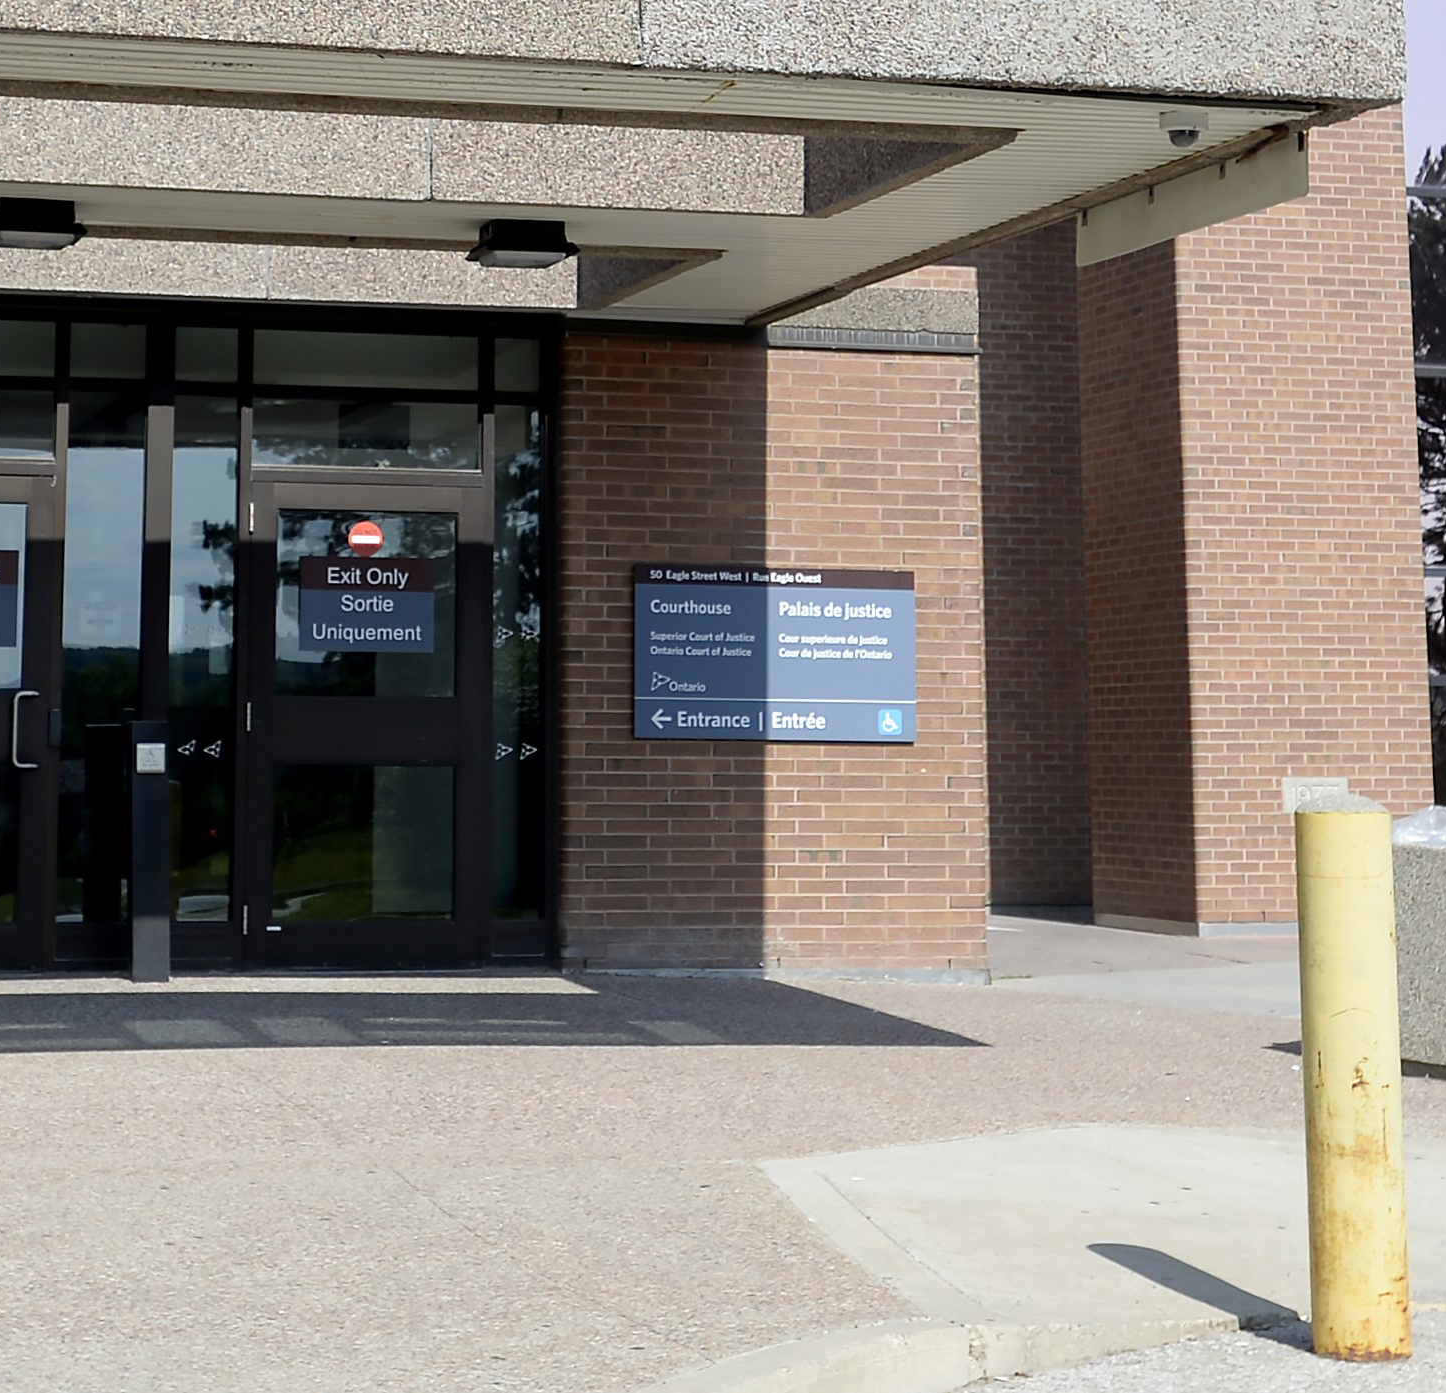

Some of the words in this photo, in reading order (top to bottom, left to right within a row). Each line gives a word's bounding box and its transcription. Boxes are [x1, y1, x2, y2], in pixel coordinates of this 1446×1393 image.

[327, 567, 362, 585] Exit
[366, 567, 409, 589] Only
[650, 570, 663, 580] 50
[666, 570, 690, 582] Eagle
[691, 571, 718, 581] Street
[719, 572, 743, 582] West
[752, 573, 769, 583] Rue
[770, 572, 794, 584] Eagle
[795, 573, 822, 584] Ouest
[341, 594, 394, 612] Sortie
[650, 599, 732, 615] Courthouse
[779, 601, 822, 617] Palais
[823, 602, 843, 618] de
[843, 602, 893, 621] justice
[312, 623, 422, 644] Uniquement
[650, 631, 687, 642] Superior
[688, 632, 714, 642] Court
[715, 632, 725, 642] of
[725, 632, 755, 643] Justice
[778, 633, 800, 644] Cour
[847, 634, 859, 645] de
[858, 634, 888, 647] justice
[650, 645, 684, 656] Ontario
[685, 646, 710, 657] Court
[711, 646, 721, 657] of
[722, 646, 752, 657] Justice
[778, 647, 800, 658] Cour
[800, 648, 812, 659] de
[812, 648, 842, 660] justice
[842, 649, 854, 659] de
[669, 681, 707, 692] Ontario
[677, 710, 751, 728] Entrance
[771, 711, 827, 730] Entrée
